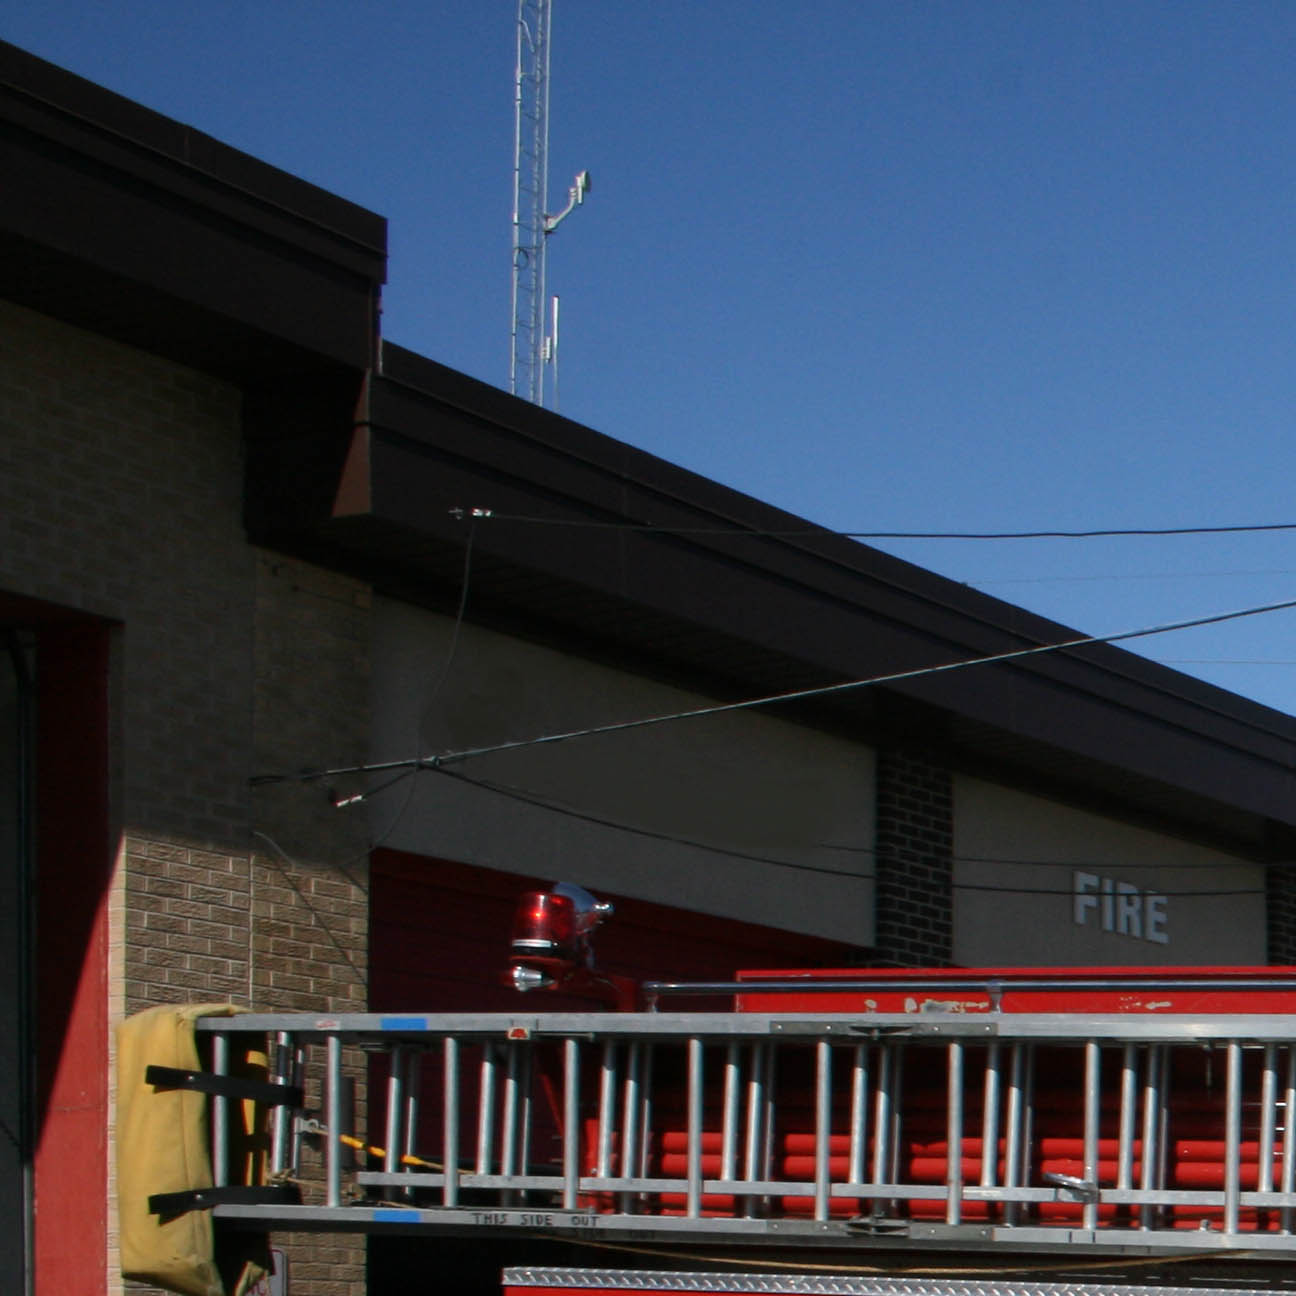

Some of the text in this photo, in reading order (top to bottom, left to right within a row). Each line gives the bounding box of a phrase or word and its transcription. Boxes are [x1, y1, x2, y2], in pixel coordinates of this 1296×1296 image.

[1073, 871, 1169, 944] FIRE
[472, 1212, 600, 1227] THIS SIDE OUT
